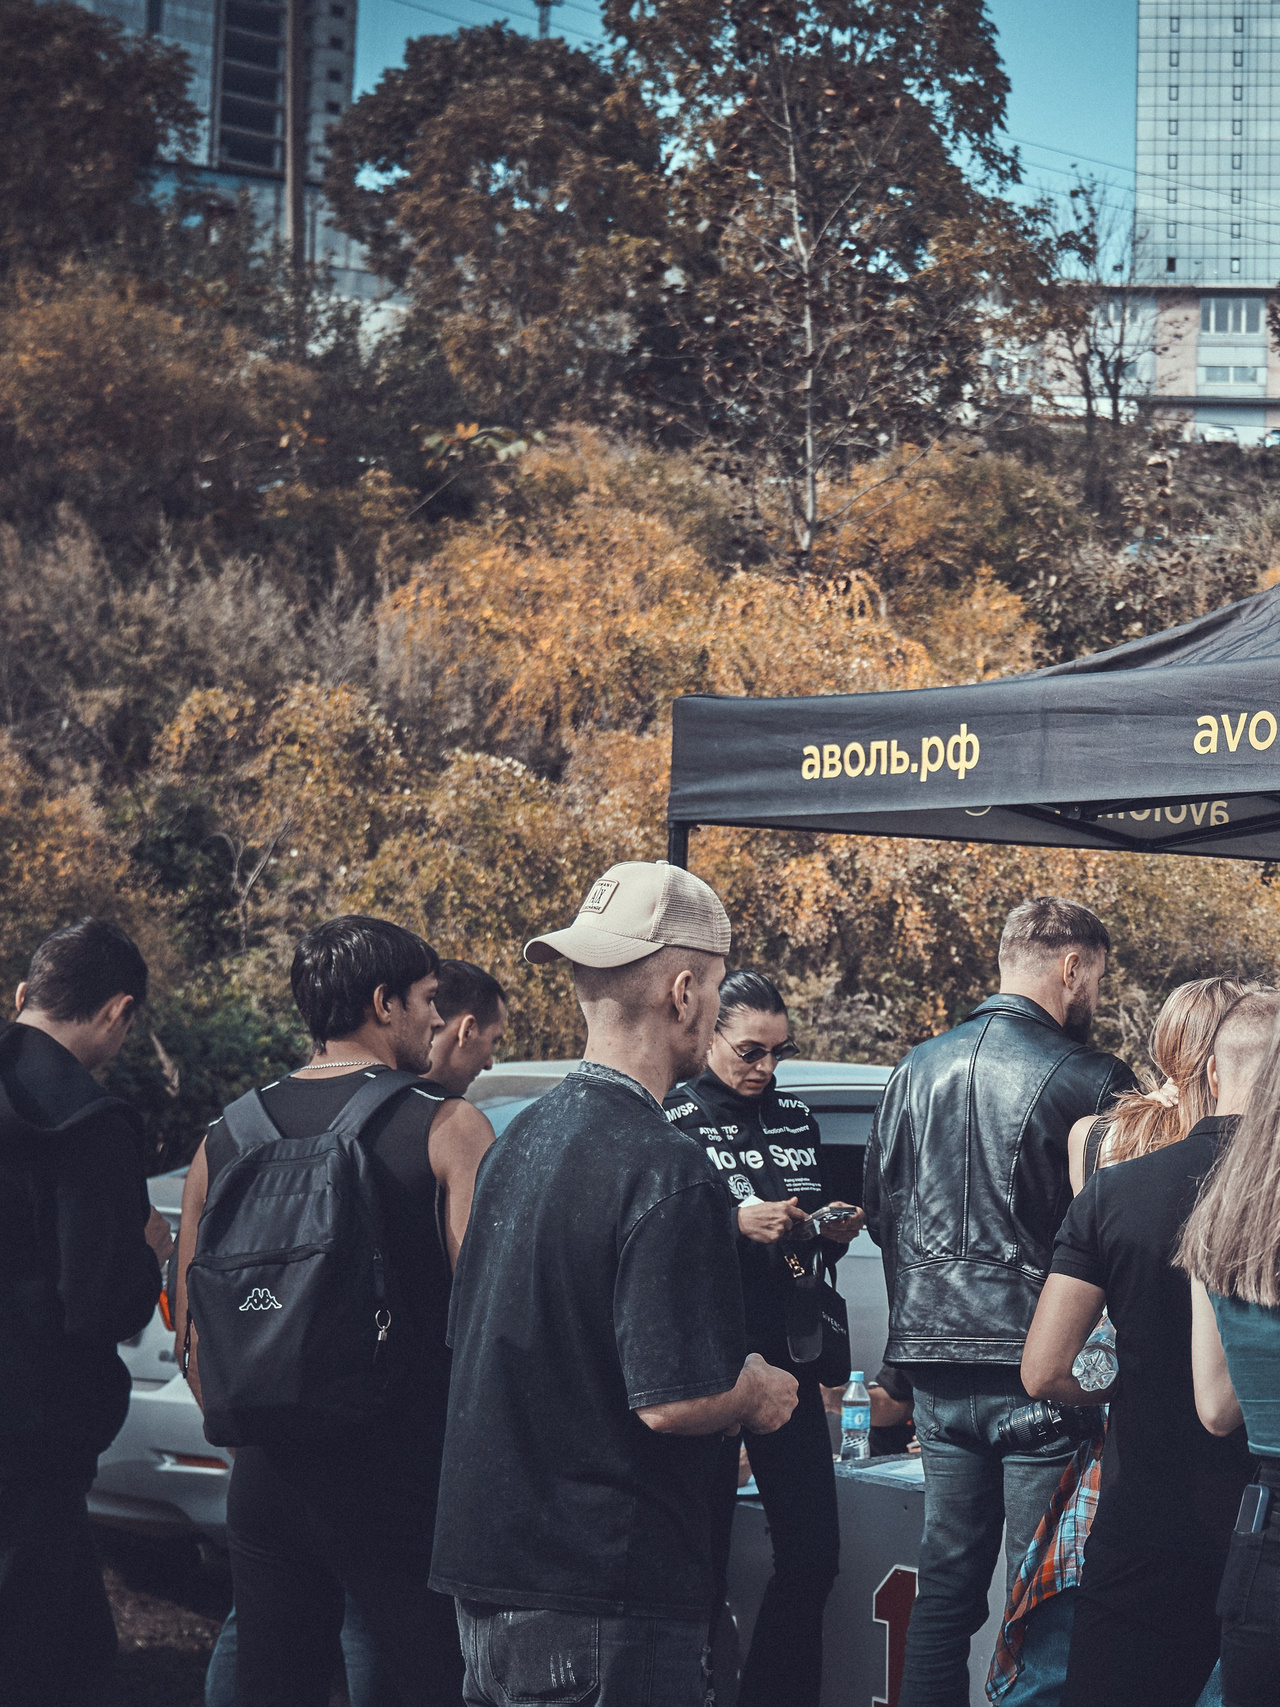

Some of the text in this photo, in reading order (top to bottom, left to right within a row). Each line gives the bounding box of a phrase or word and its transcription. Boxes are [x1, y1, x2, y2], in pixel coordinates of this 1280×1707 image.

[801, 723, 981, 782] аволь.рф
[665, 1102, 699, 1123] MVSP.
[699, 1125, 739, 1136] ATHTIC
